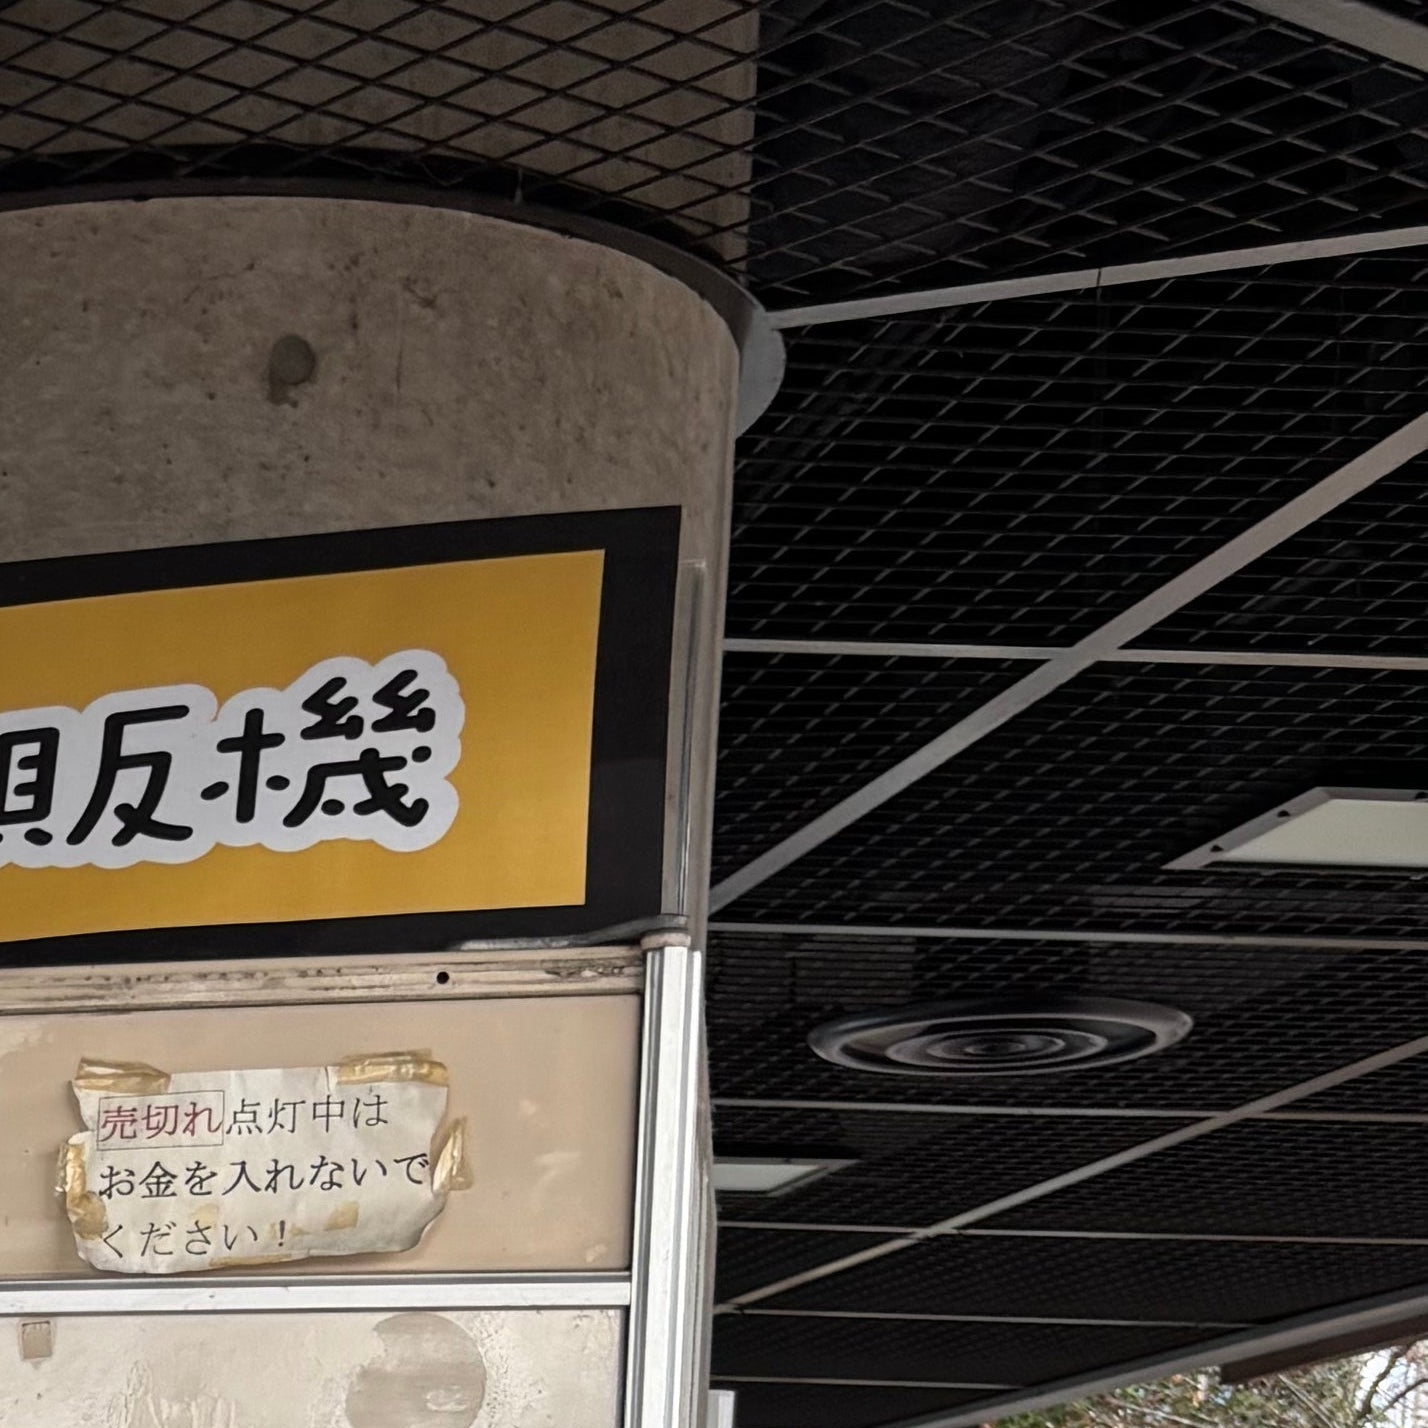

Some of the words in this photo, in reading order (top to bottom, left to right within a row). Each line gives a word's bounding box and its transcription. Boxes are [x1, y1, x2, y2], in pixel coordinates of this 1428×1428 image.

[99, 1095, 390, 1143] 売切れ点灯中は
[98, 1151, 431, 1200] お金を入れないで
